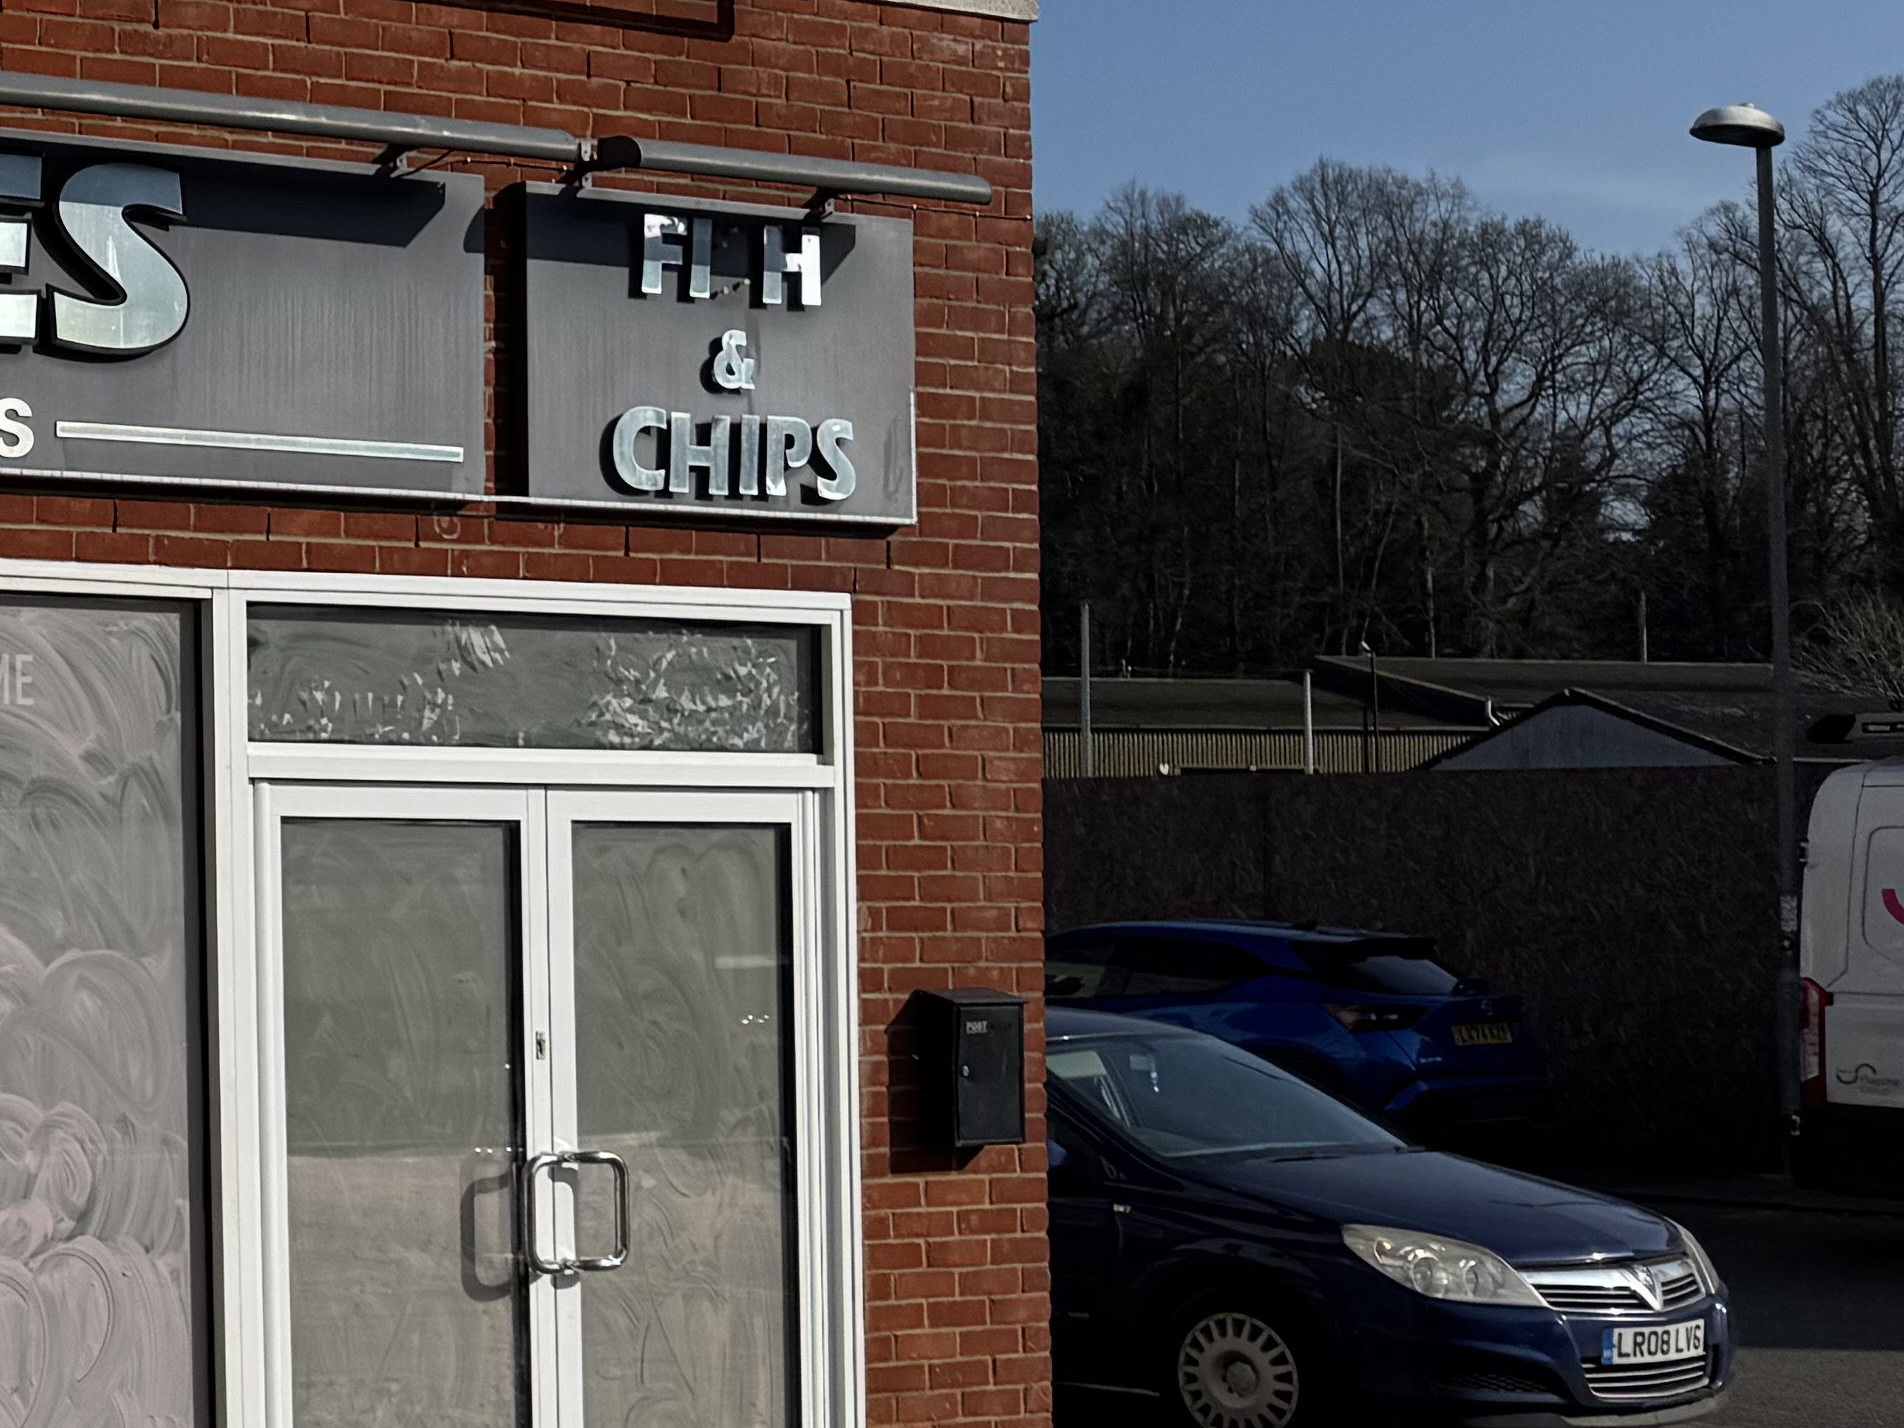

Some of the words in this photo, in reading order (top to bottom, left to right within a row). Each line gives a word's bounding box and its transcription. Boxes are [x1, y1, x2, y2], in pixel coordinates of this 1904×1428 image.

[641, 213, 822, 306] FIH
[713, 329, 756, 390] &
[612, 405, 857, 501] CHIPS
[1617, 1329, 1671, 1359] LR08
